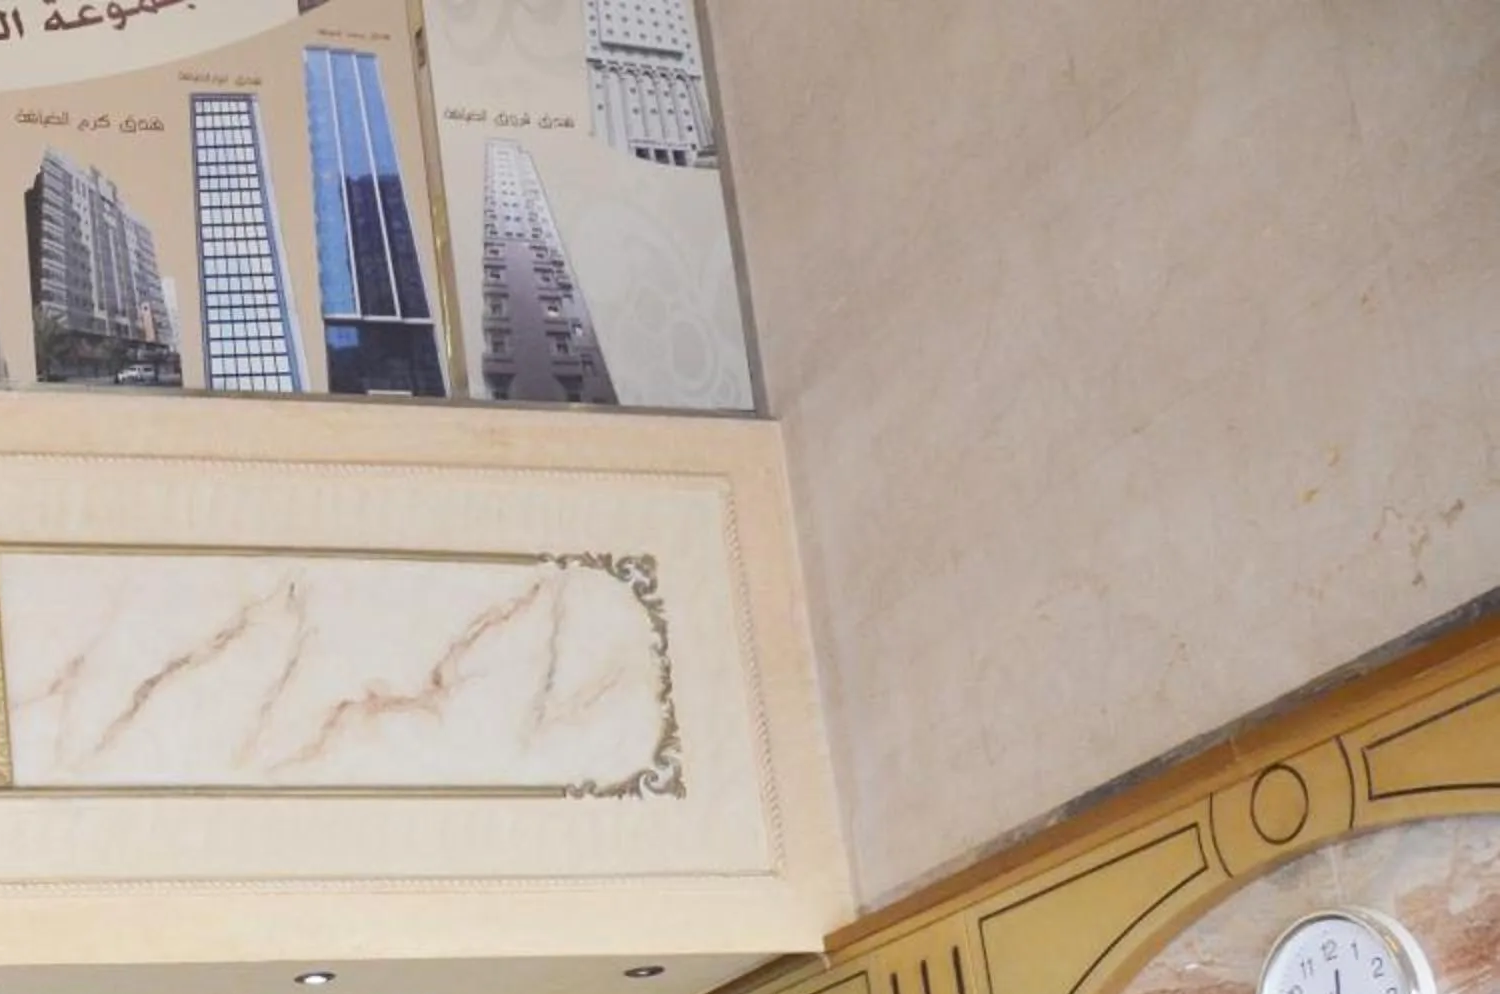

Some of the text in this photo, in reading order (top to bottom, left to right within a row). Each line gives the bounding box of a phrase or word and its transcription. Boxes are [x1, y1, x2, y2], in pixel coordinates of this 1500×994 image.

[14, 108, 69, 128] الضيافة
[119, 114, 165, 133] فندق
[1322, 940, 1338, 961] 12
[1350, 942, 1359, 960] 1
[1301, 959, 1314, 979] 11
[1371, 957, 1384, 978] 2
